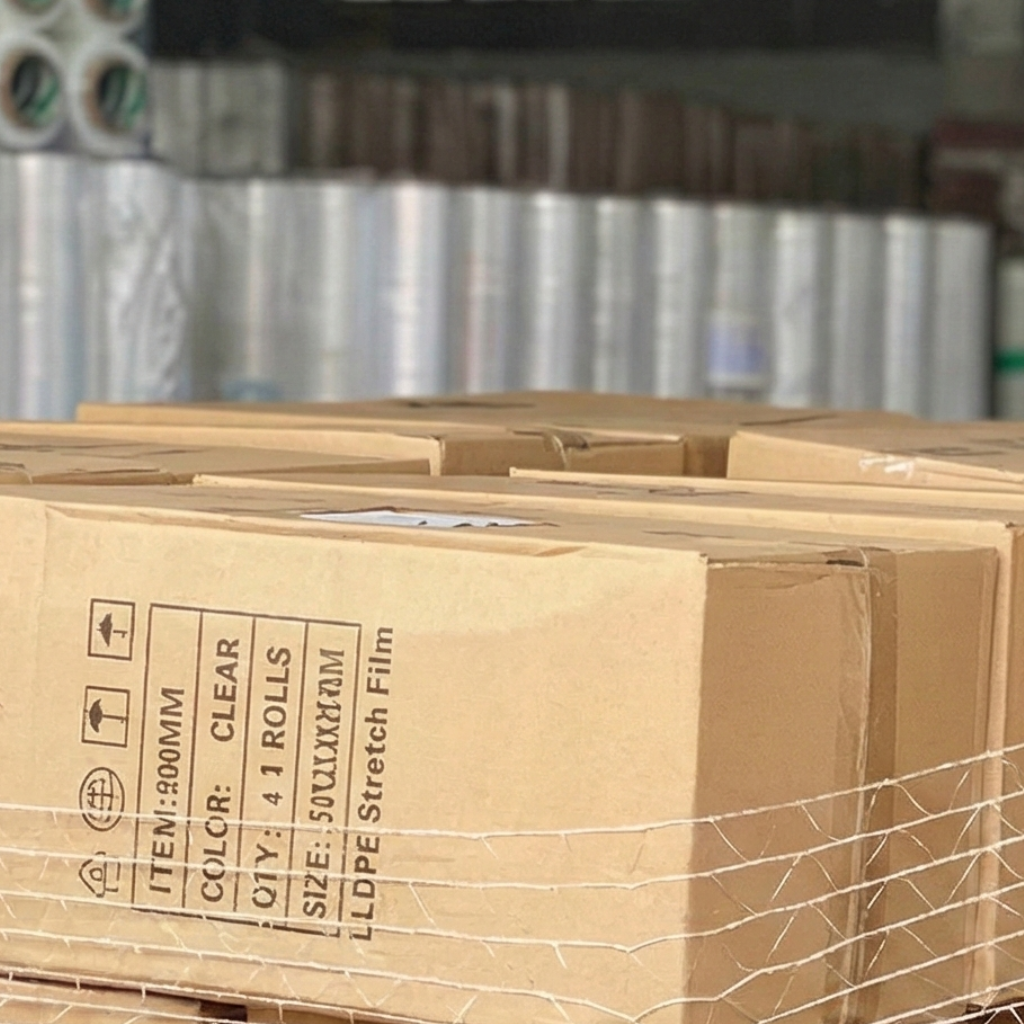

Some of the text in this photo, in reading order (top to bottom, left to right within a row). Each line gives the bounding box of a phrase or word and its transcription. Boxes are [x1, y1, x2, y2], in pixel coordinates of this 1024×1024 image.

[201, 638, 240, 902] COLOR: CLEAR
[261, 646, 291, 749] ROLLS
[349, 627, 393, 941] LLDPE Stretch Film
[302, 842, 331, 918] SIZE:
